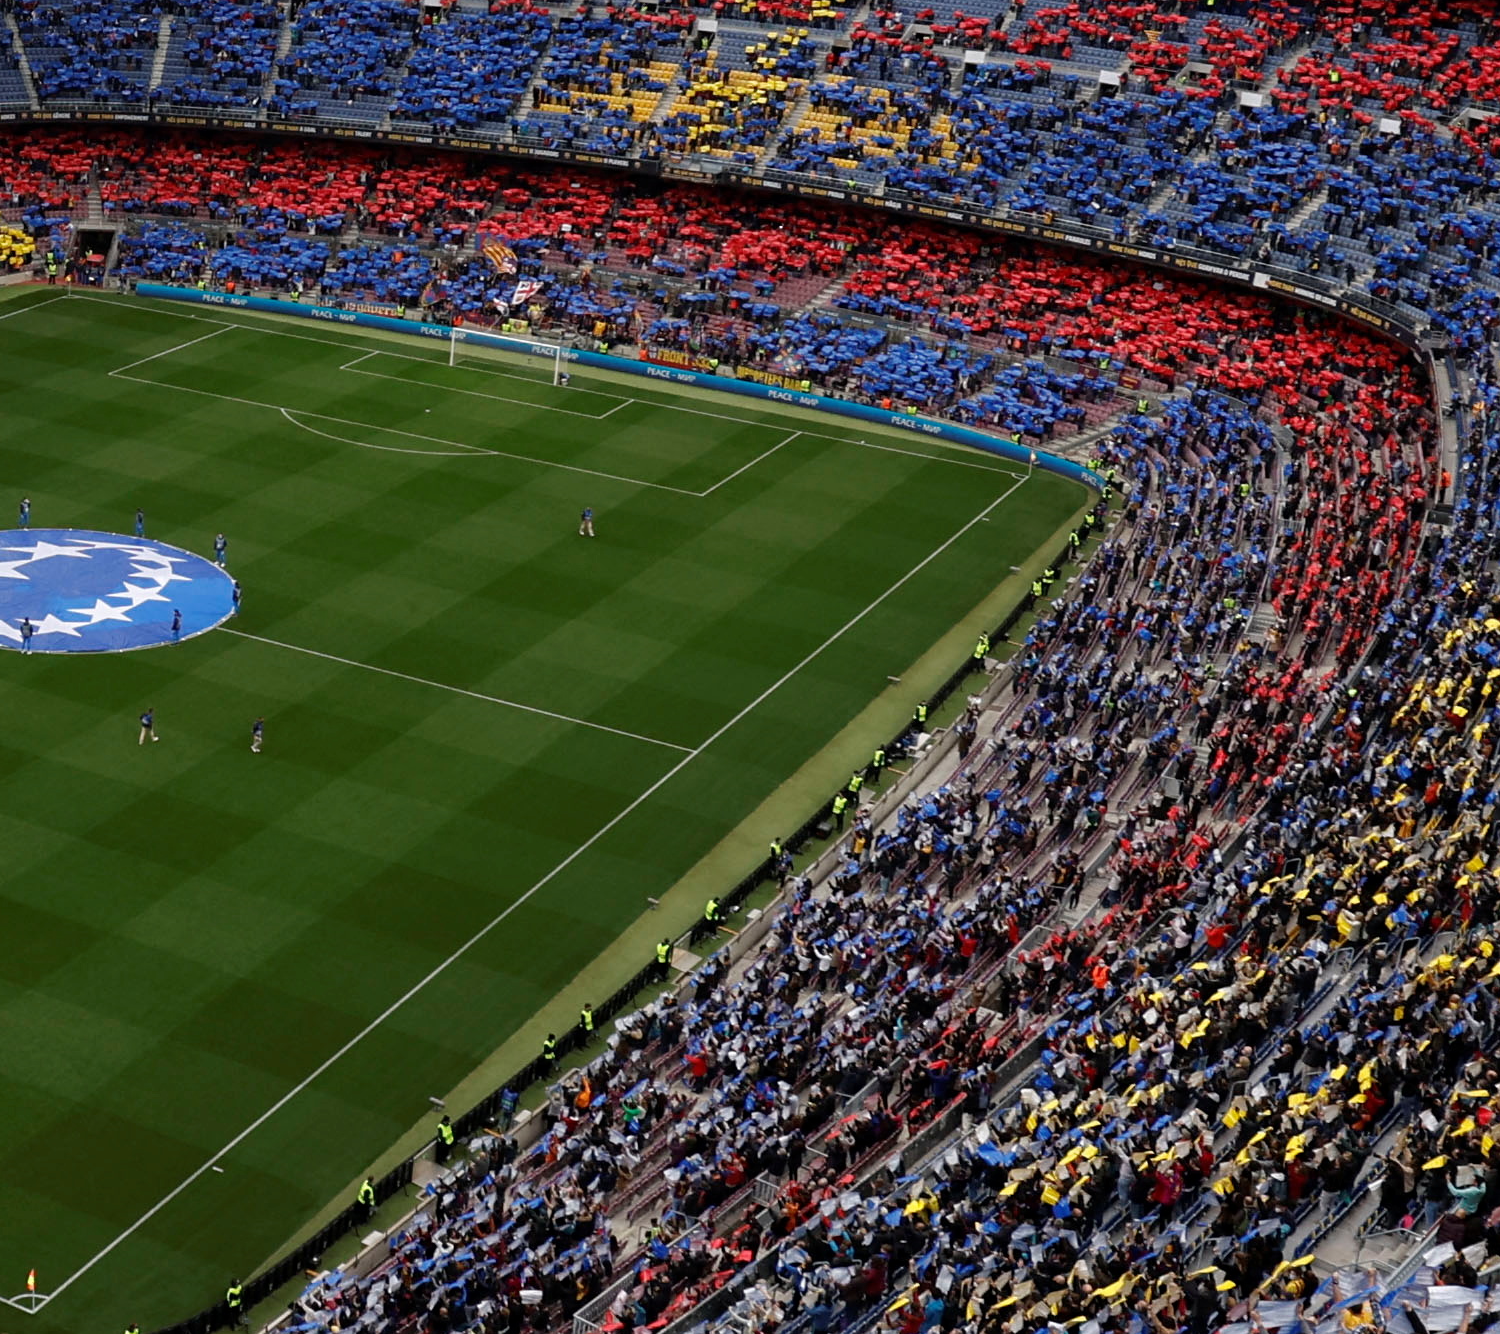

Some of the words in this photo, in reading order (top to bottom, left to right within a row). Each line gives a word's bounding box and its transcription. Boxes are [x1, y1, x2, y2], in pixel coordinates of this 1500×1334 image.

[202, 293, 226, 305] PEACE
[311, 308, 335, 319] PEACE
[420, 325, 443, 337] PEACE
[531, 345, 555, 357] PEACE
[646, 366, 670, 380] PEACE
[768, 390, 792, 402] PEACE
[891, 416, 917, 429] PEACE
